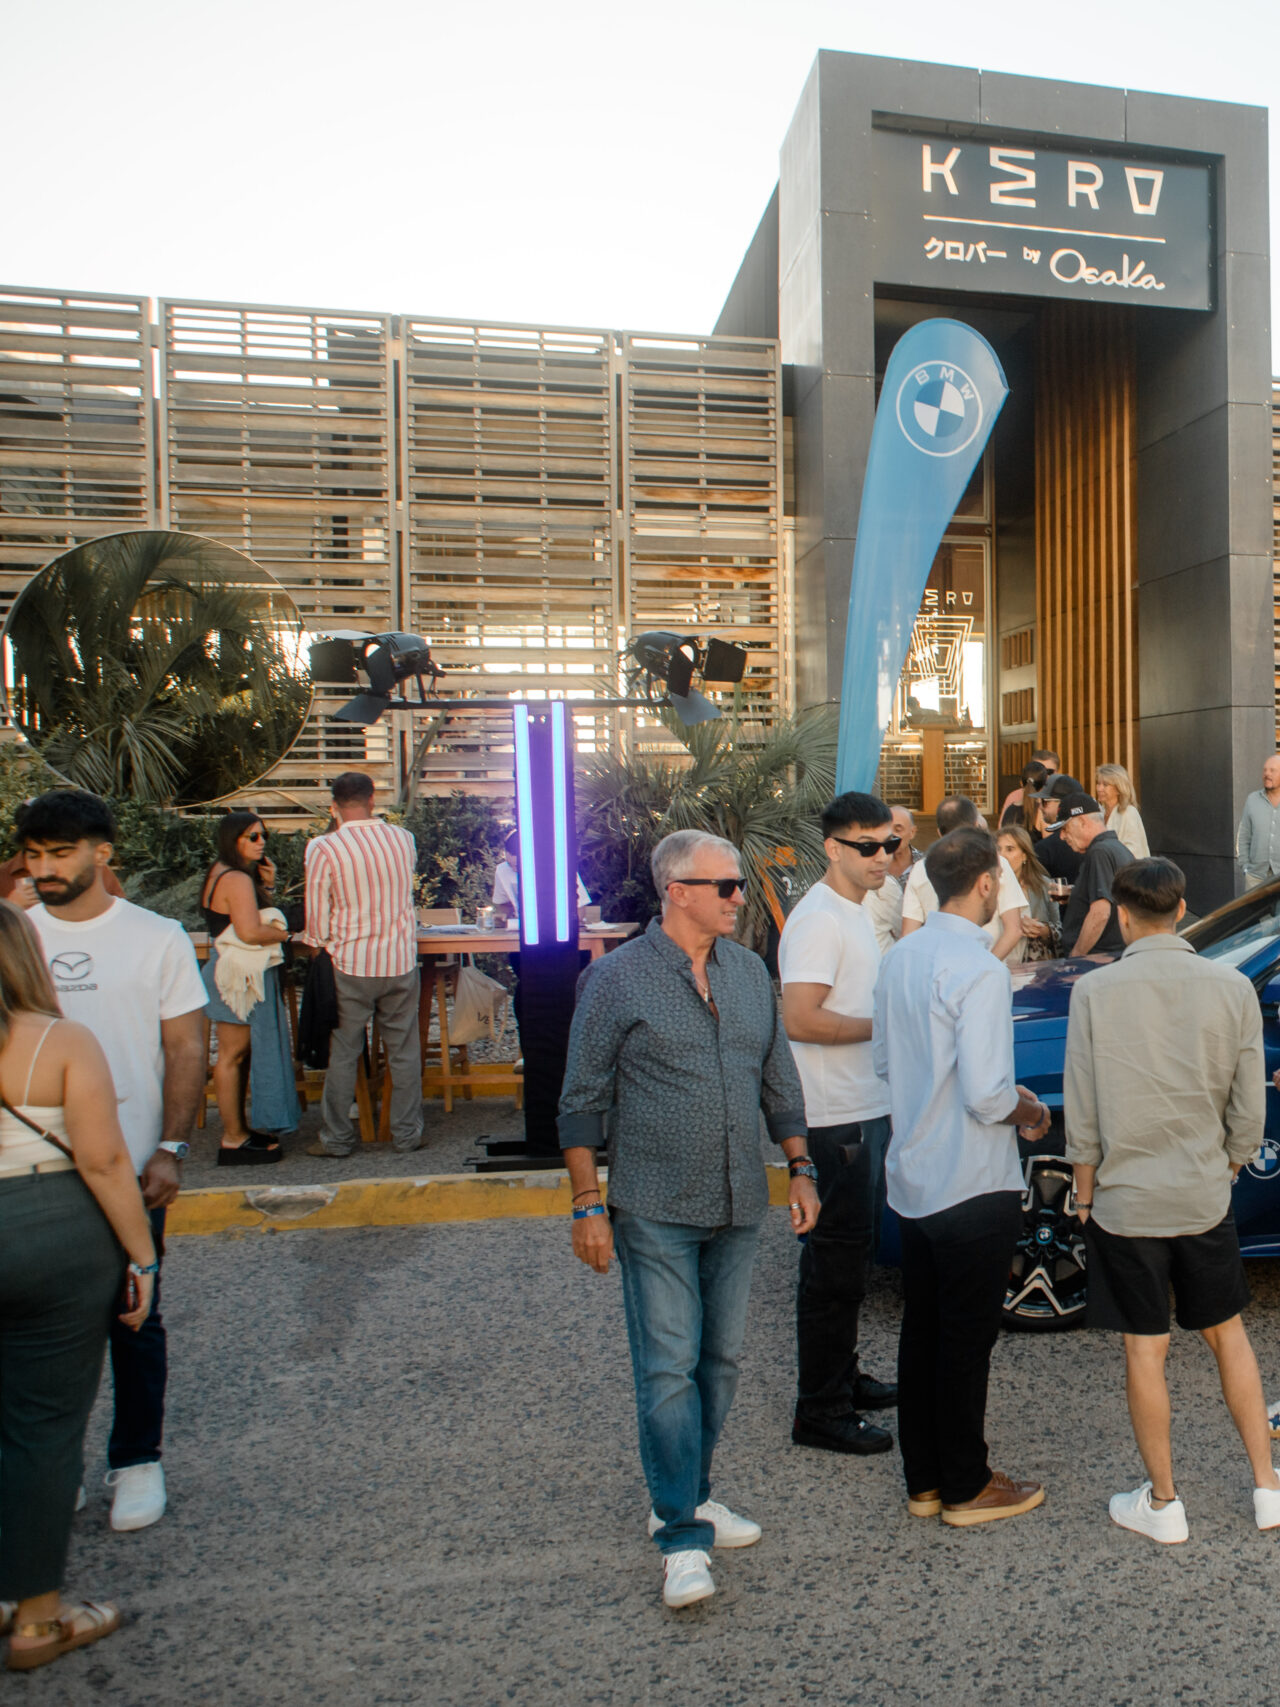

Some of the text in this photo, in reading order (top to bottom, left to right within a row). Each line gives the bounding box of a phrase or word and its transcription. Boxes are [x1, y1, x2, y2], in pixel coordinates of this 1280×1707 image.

[1023, 246, 1041, 264] by
[1049, 247, 1166, 290] Osaka
[915, 366, 974, 401] BMW
[924, 588, 973, 605] ERO
